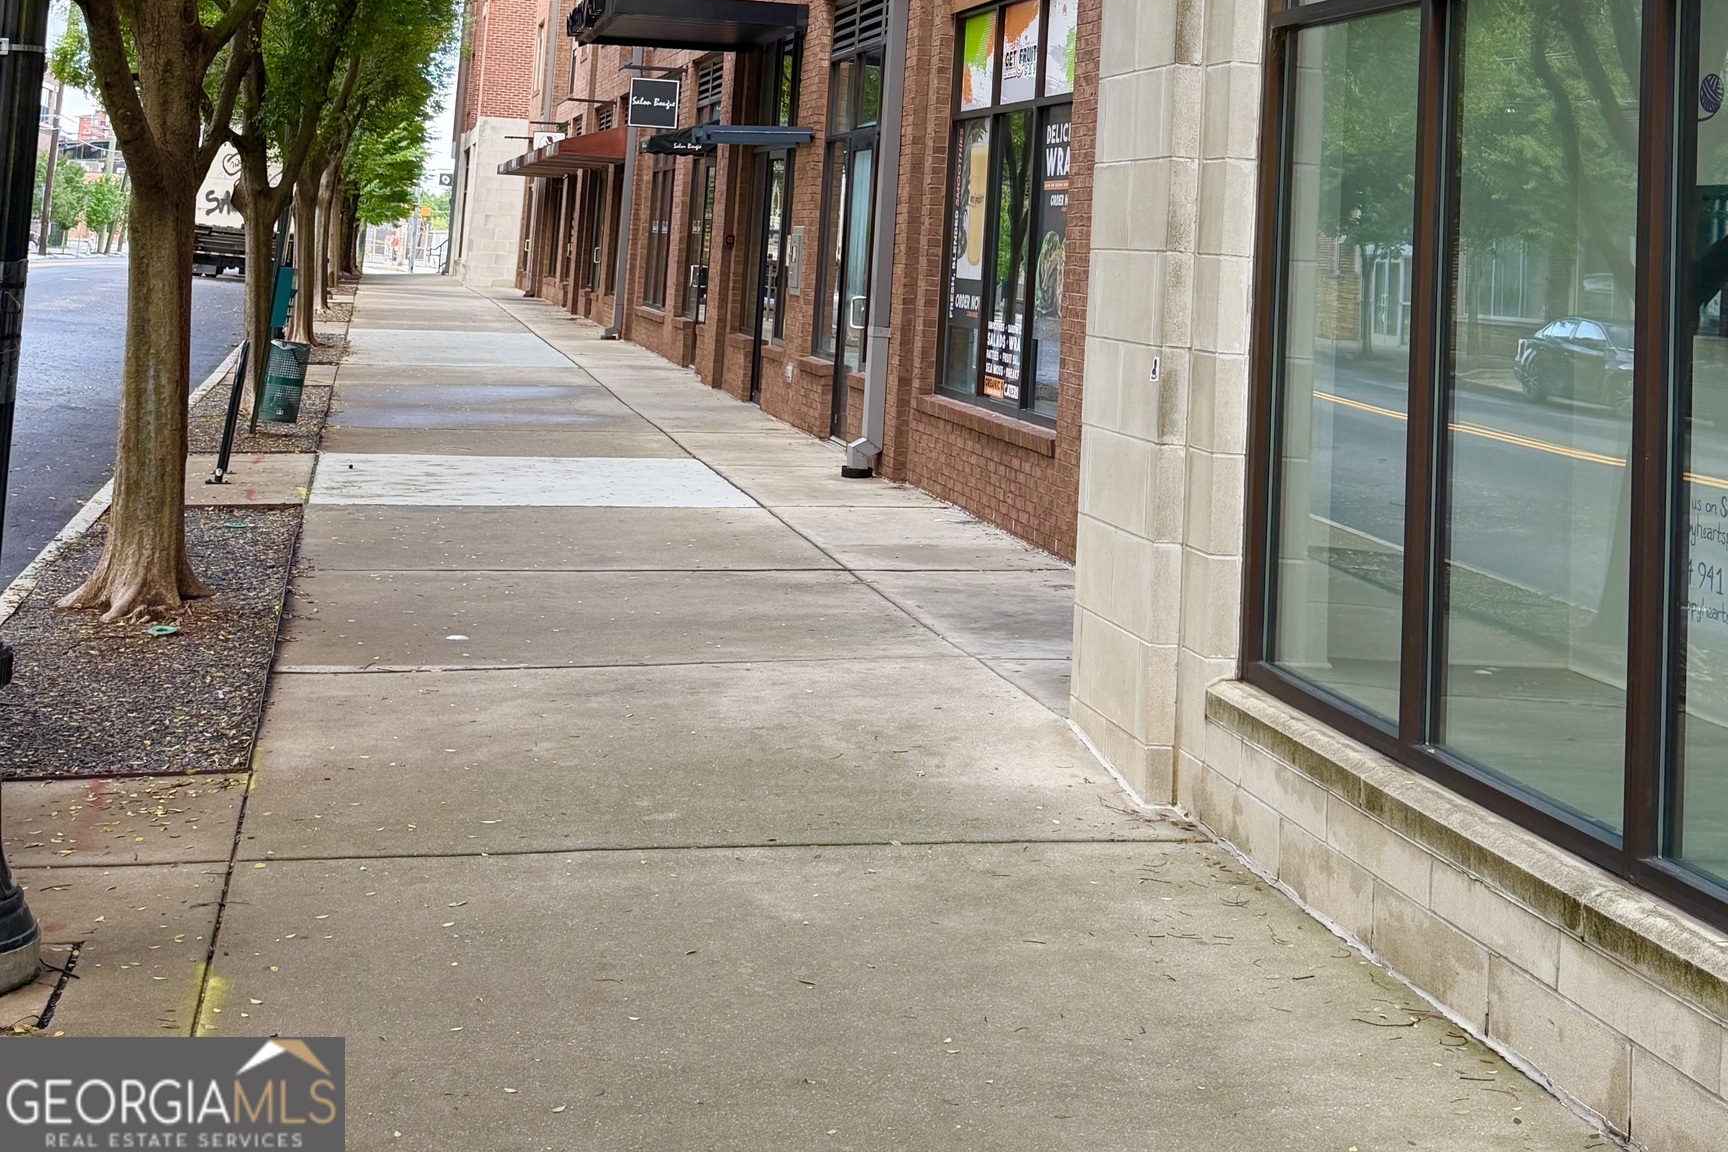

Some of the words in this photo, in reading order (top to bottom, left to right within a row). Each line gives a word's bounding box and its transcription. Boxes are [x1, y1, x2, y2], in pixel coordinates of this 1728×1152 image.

[1004, 50, 1017, 68] GET
[632, 96, 652, 106] Salon
[955, 294, 970, 310] ORDER
[1692, 498, 1701, 512] us
[1705, 502, 1717, 514] on
[1698, 562, 1724, 595] 941
